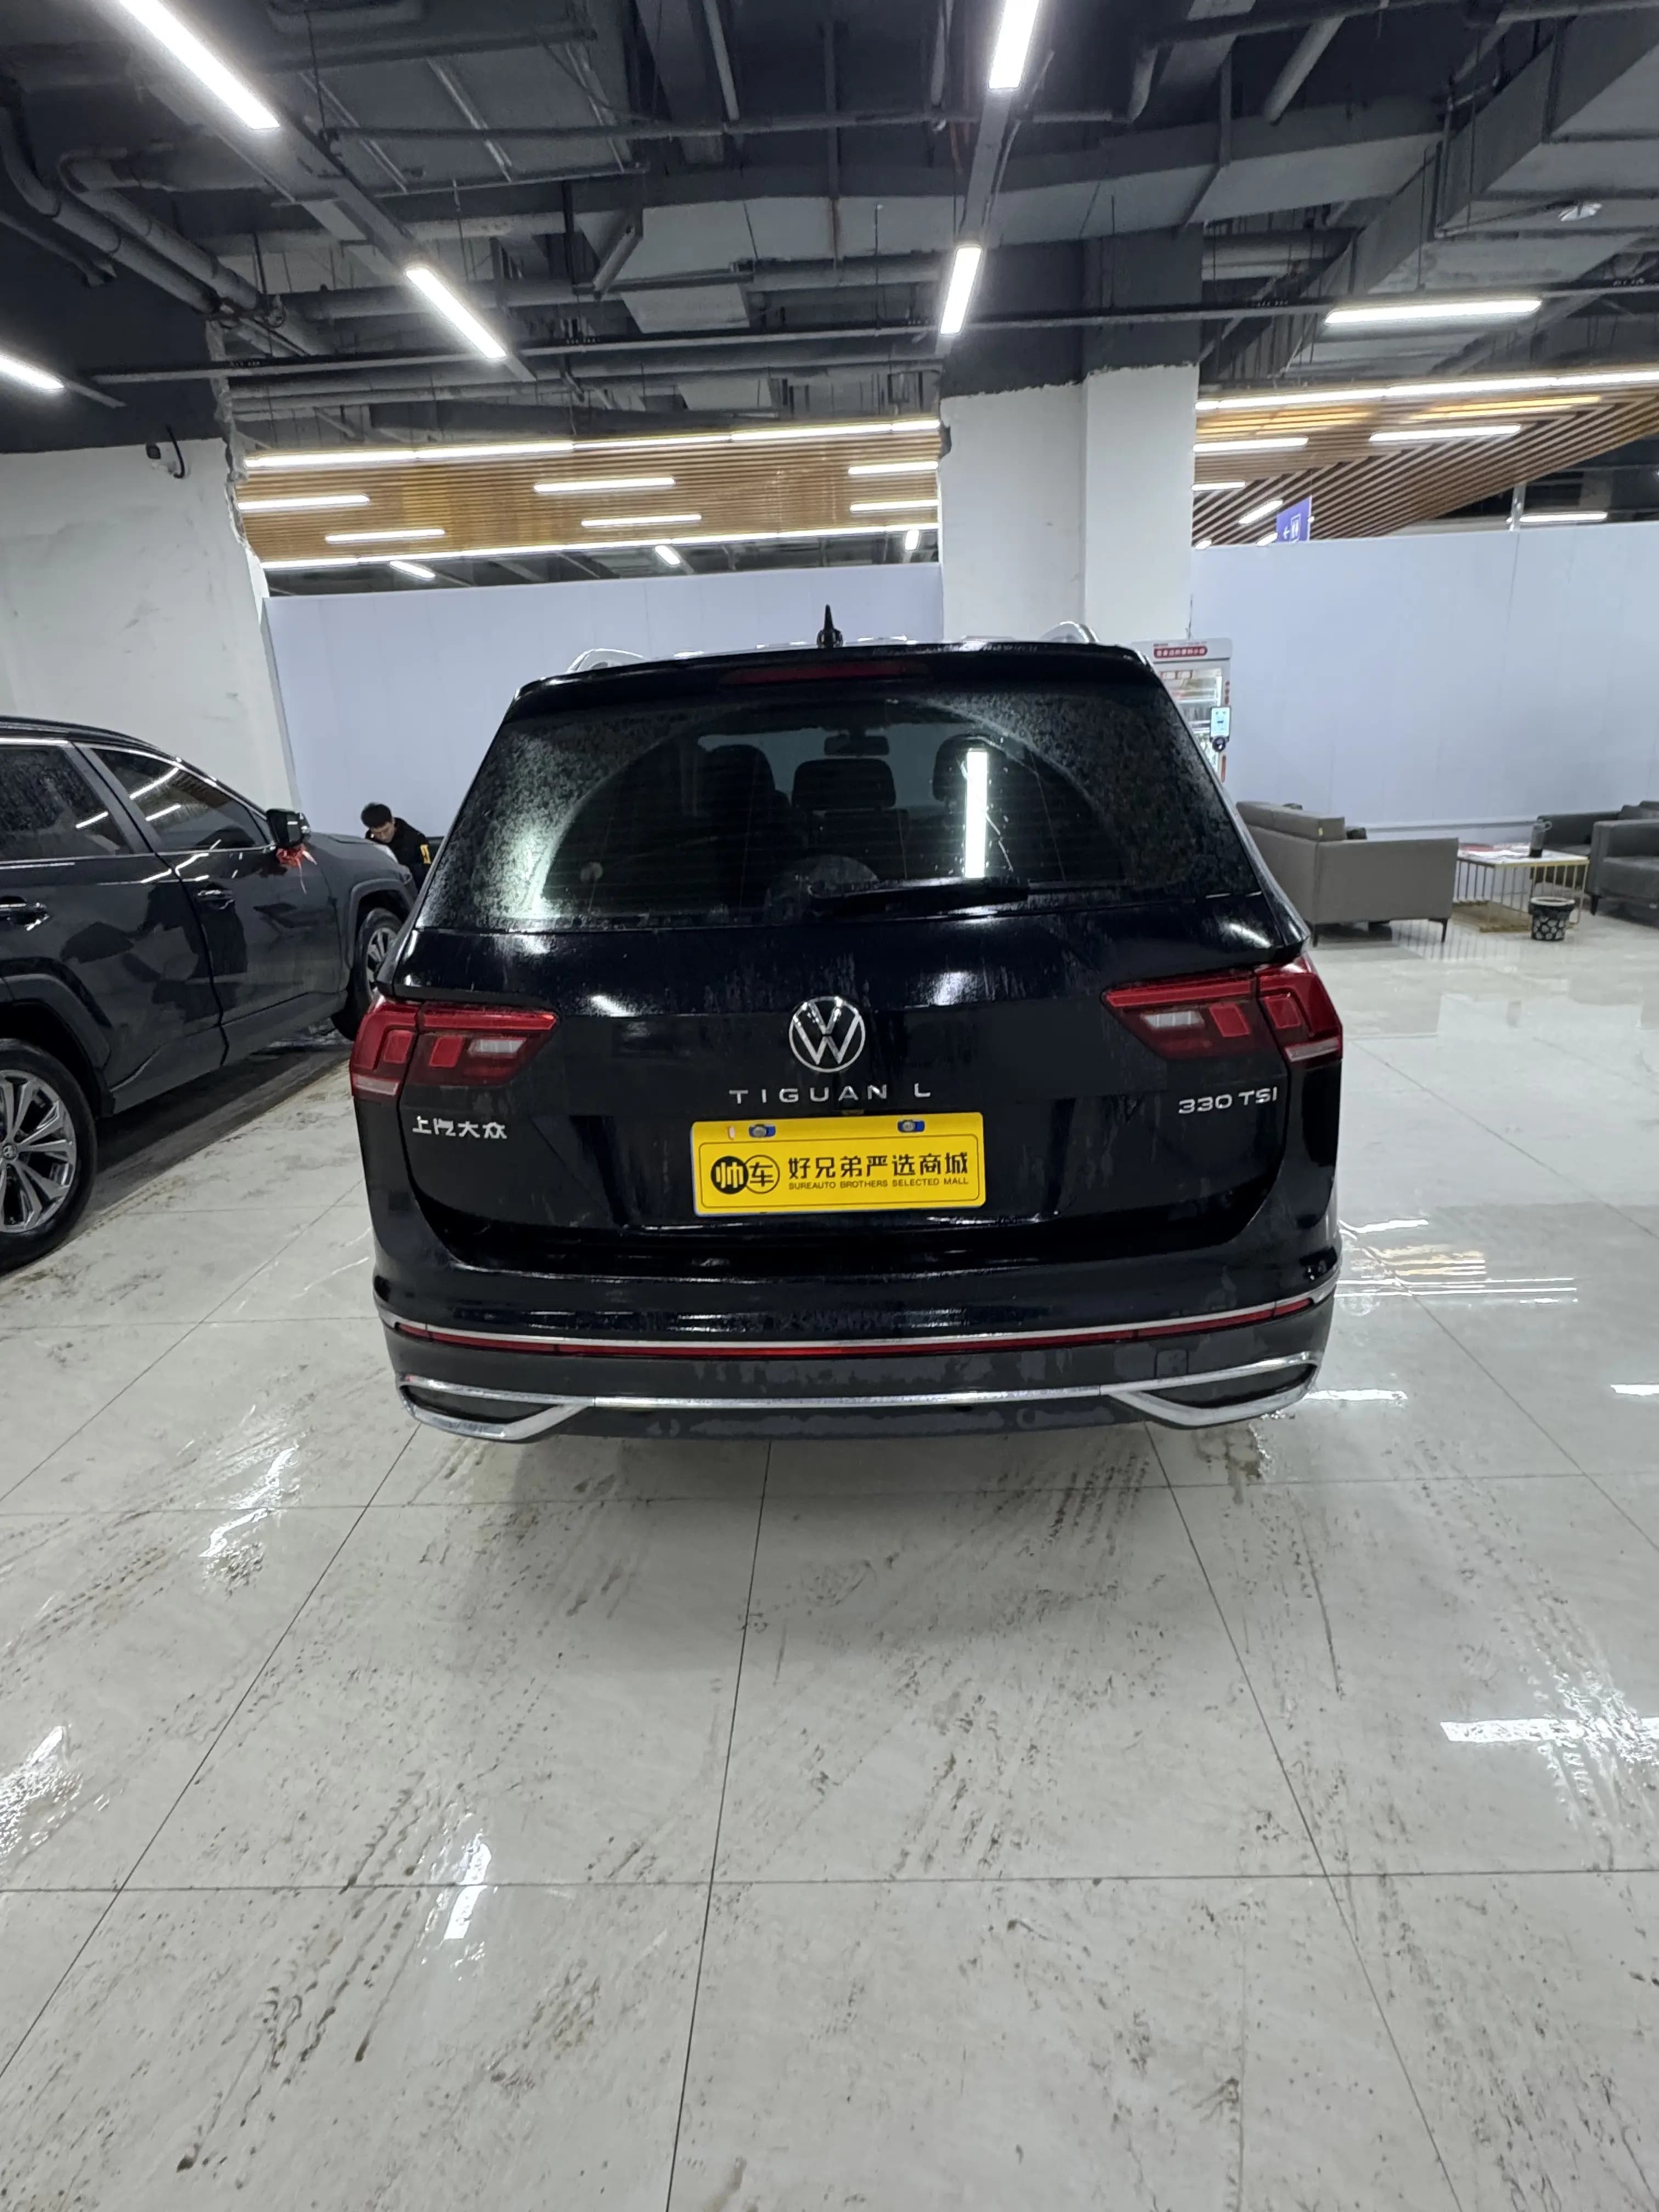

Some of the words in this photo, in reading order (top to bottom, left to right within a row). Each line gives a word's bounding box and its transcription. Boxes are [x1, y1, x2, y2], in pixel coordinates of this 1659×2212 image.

[729, 1084, 888, 1104] TIGUAN
[913, 1082, 932, 1097] L
[1178, 1094, 1233, 1114] 330
[1238, 1086, 1278, 1106] TSI
[412, 1115, 507, 1139] 上汽大众
[788, 1152, 969, 1180] 好兄弟严选商城
[788, 1181, 837, 1190] SUREAUTO
[840, 1179, 888, 1188] BROTHERS
[892, 1177, 940, 1187] SELECTED
[944, 1177, 969, 1185] MALL
